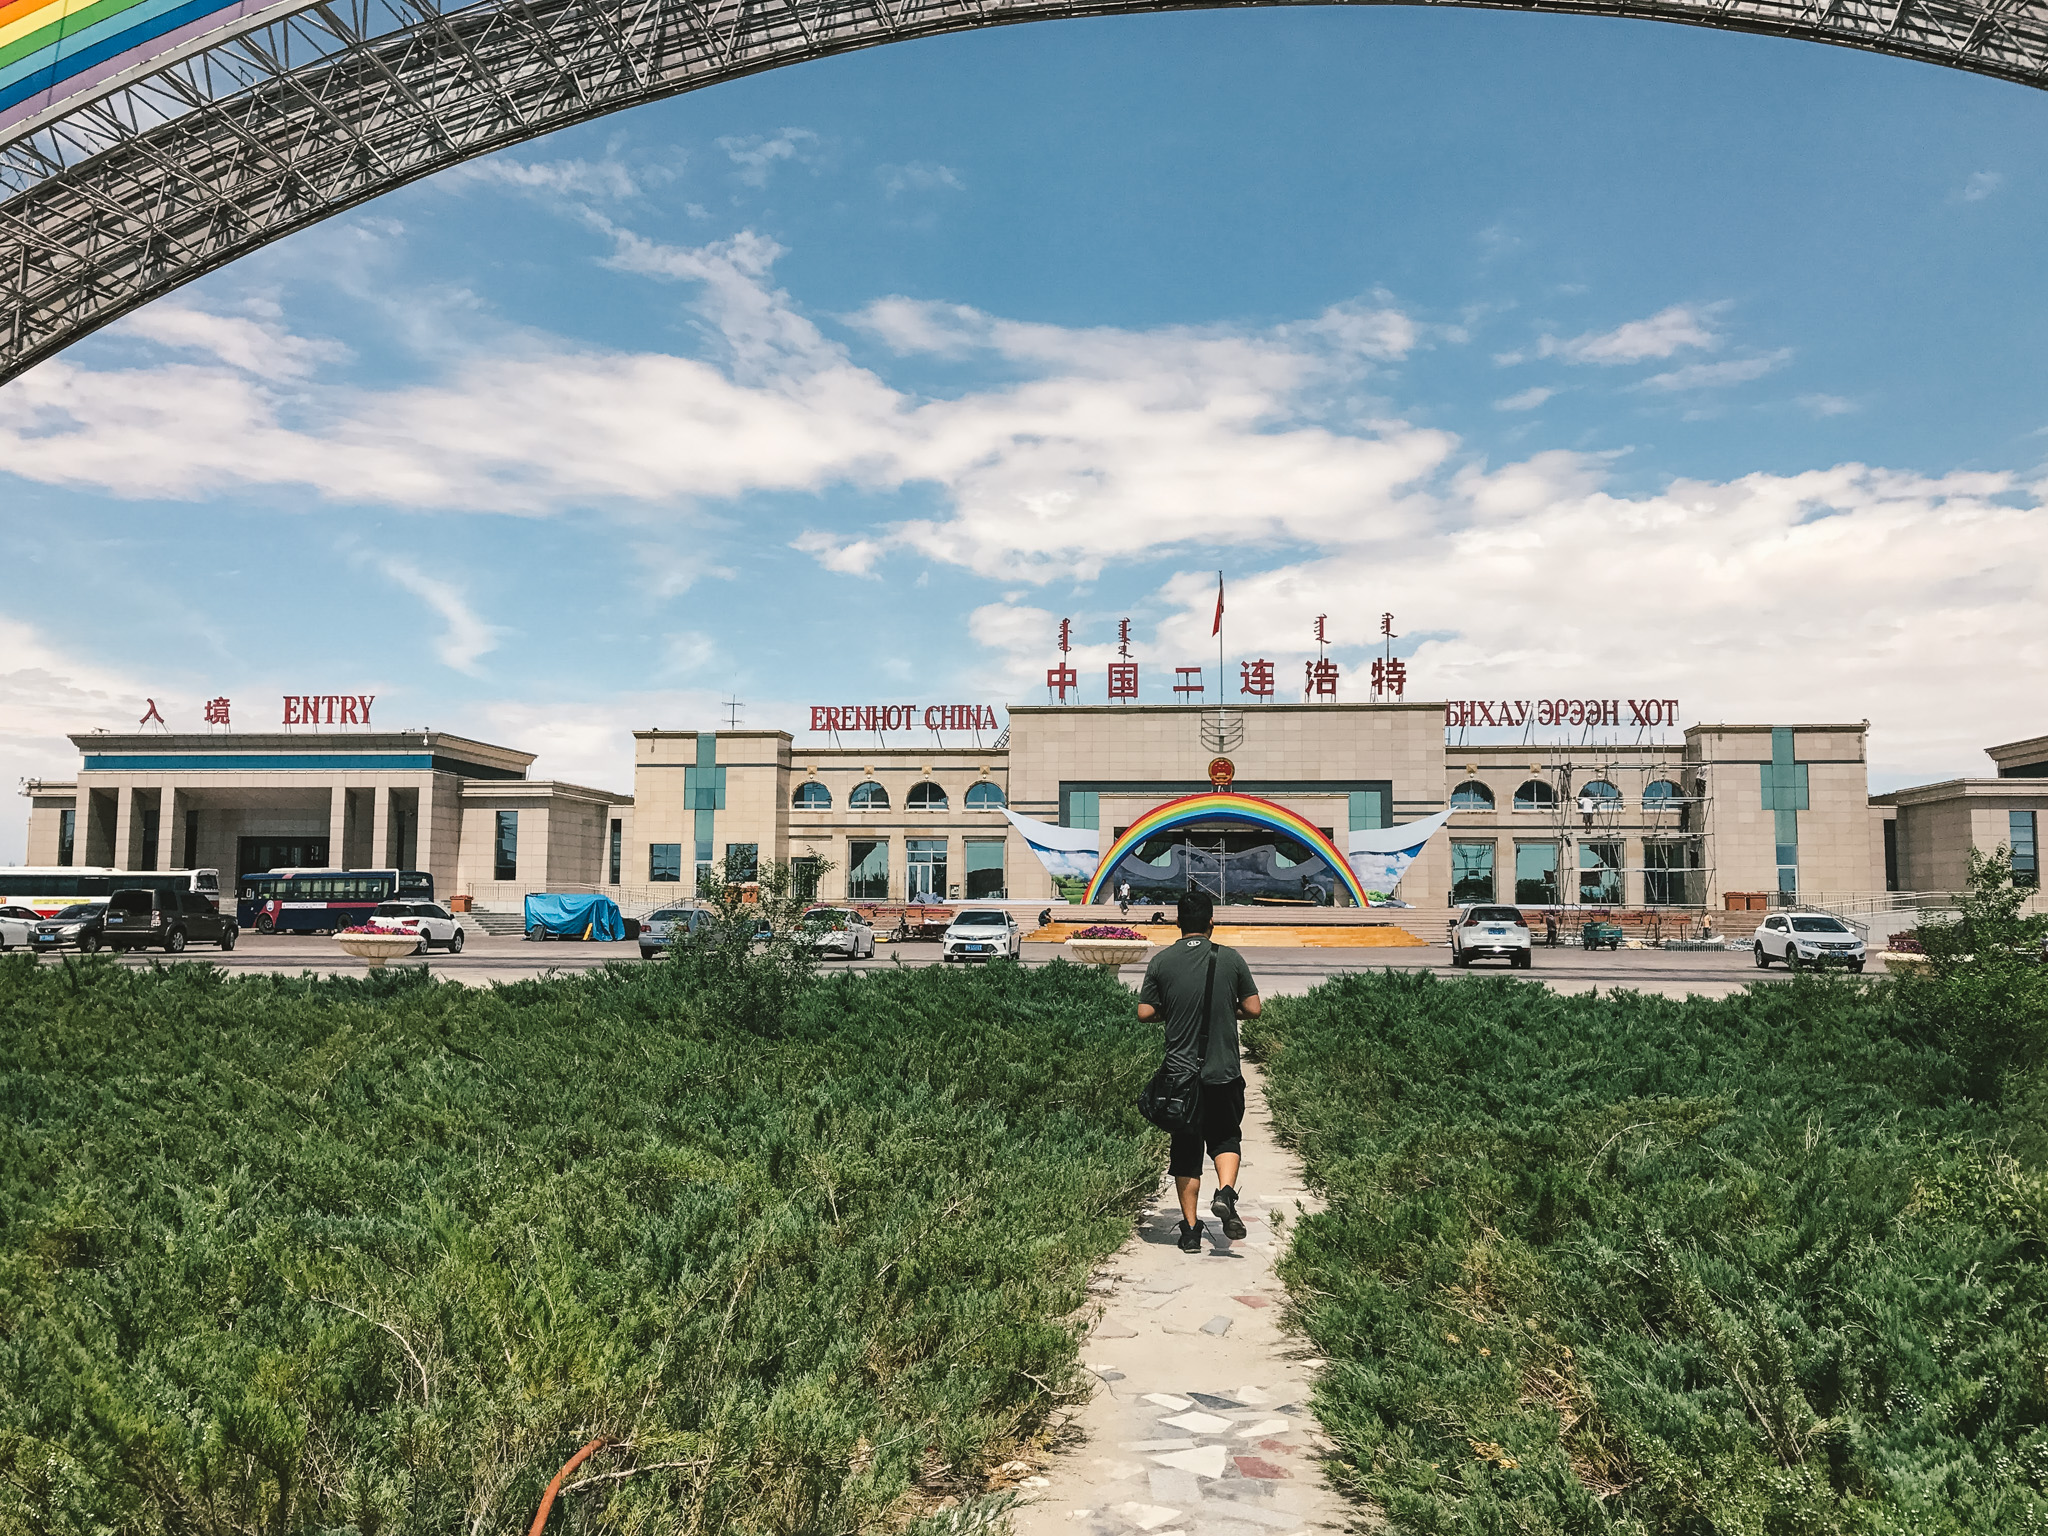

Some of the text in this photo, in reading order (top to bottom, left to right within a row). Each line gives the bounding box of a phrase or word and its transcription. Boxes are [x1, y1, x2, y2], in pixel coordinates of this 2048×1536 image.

[1047, 657, 1407, 699] 中国二连浩特
[139, 696, 231, 725] 入境
[282, 695, 376, 724] ENTRY
[809, 705, 999, 731] ERENHOT CHINA
[1445, 699, 1680, 727] БНХАУ ЭРЭЭН ХОТ
